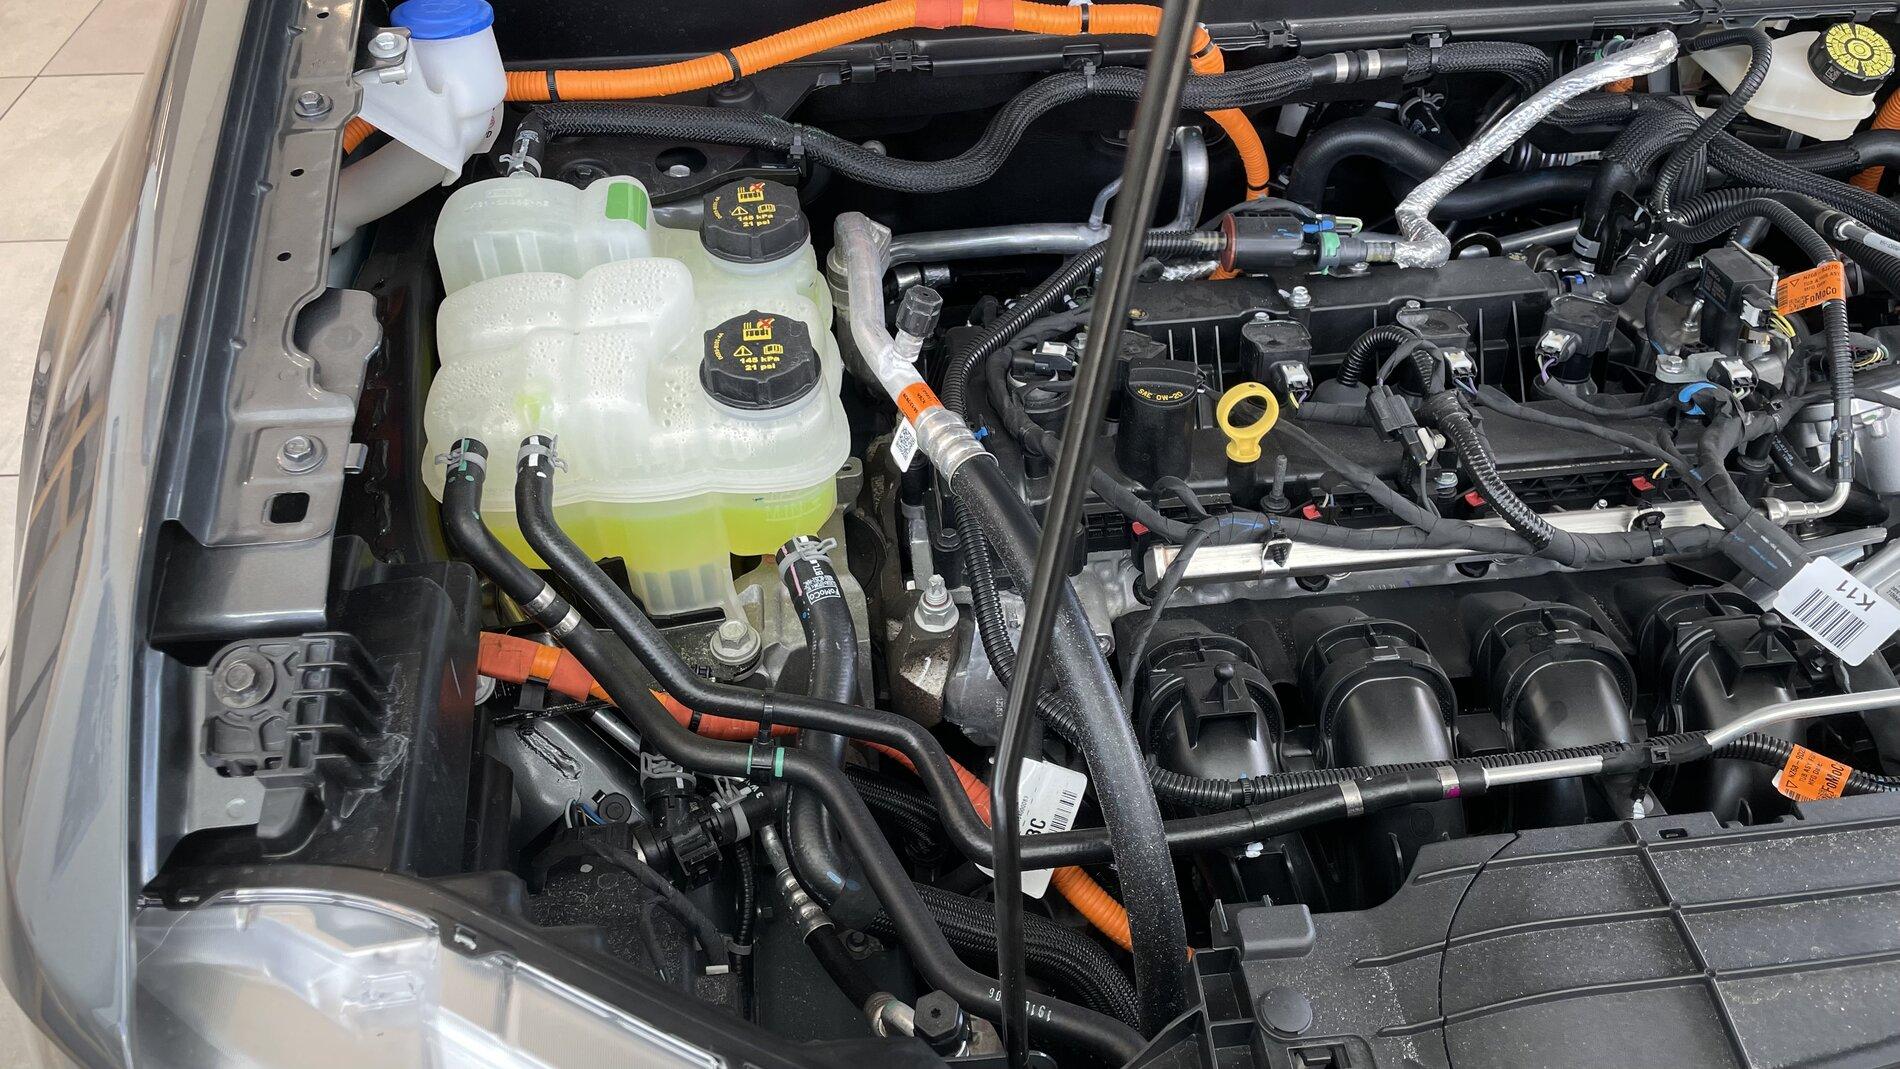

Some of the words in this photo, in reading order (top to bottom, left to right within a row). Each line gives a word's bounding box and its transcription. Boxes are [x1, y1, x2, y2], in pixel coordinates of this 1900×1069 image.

[743, 220, 754, 228] 21
[757, 219, 770, 227] psi
[1804, 286, 1837, 304] FoMoCo
[760, 363, 776, 371] psi
[1137, 388, 1153, 399] SAE
[1156, 391, 1184, 401] 0W-20
[1835, 580, 1876, 612] K11
